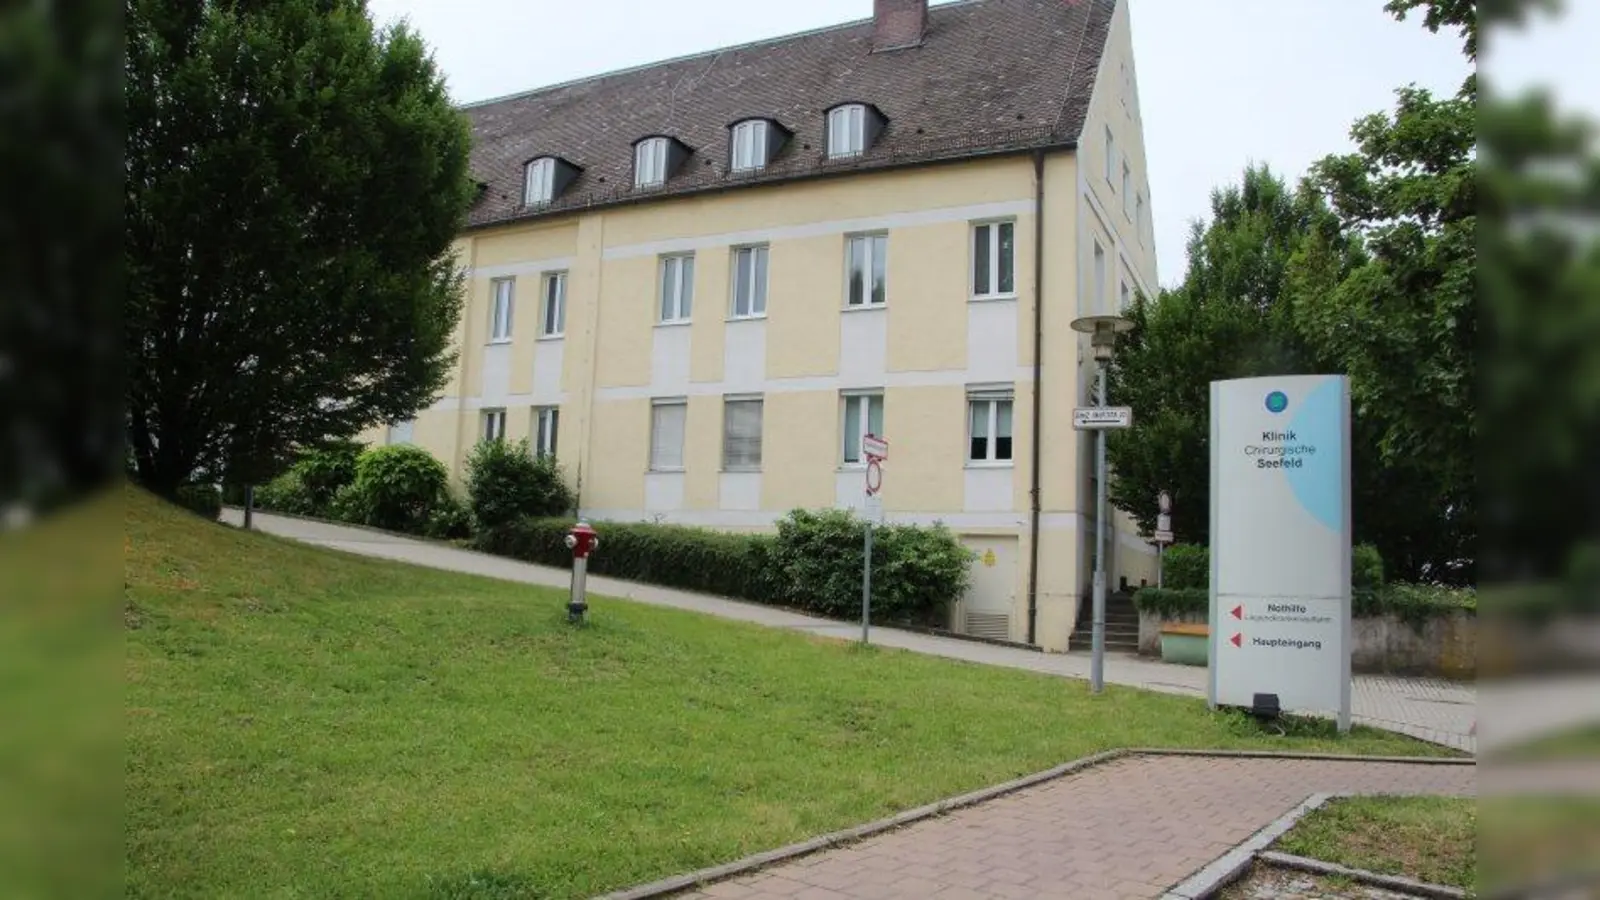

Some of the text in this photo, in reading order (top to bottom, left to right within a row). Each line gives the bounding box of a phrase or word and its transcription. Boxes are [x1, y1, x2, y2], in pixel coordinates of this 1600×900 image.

[1263, 431, 1297, 442] Klinik
[1244, 445, 1317, 456] Chirurgische
[1257, 457, 1303, 469] Seefeld
[1267, 604, 1307, 614] Nothilfe
[1252, 638, 1322, 650] Haupteingang
